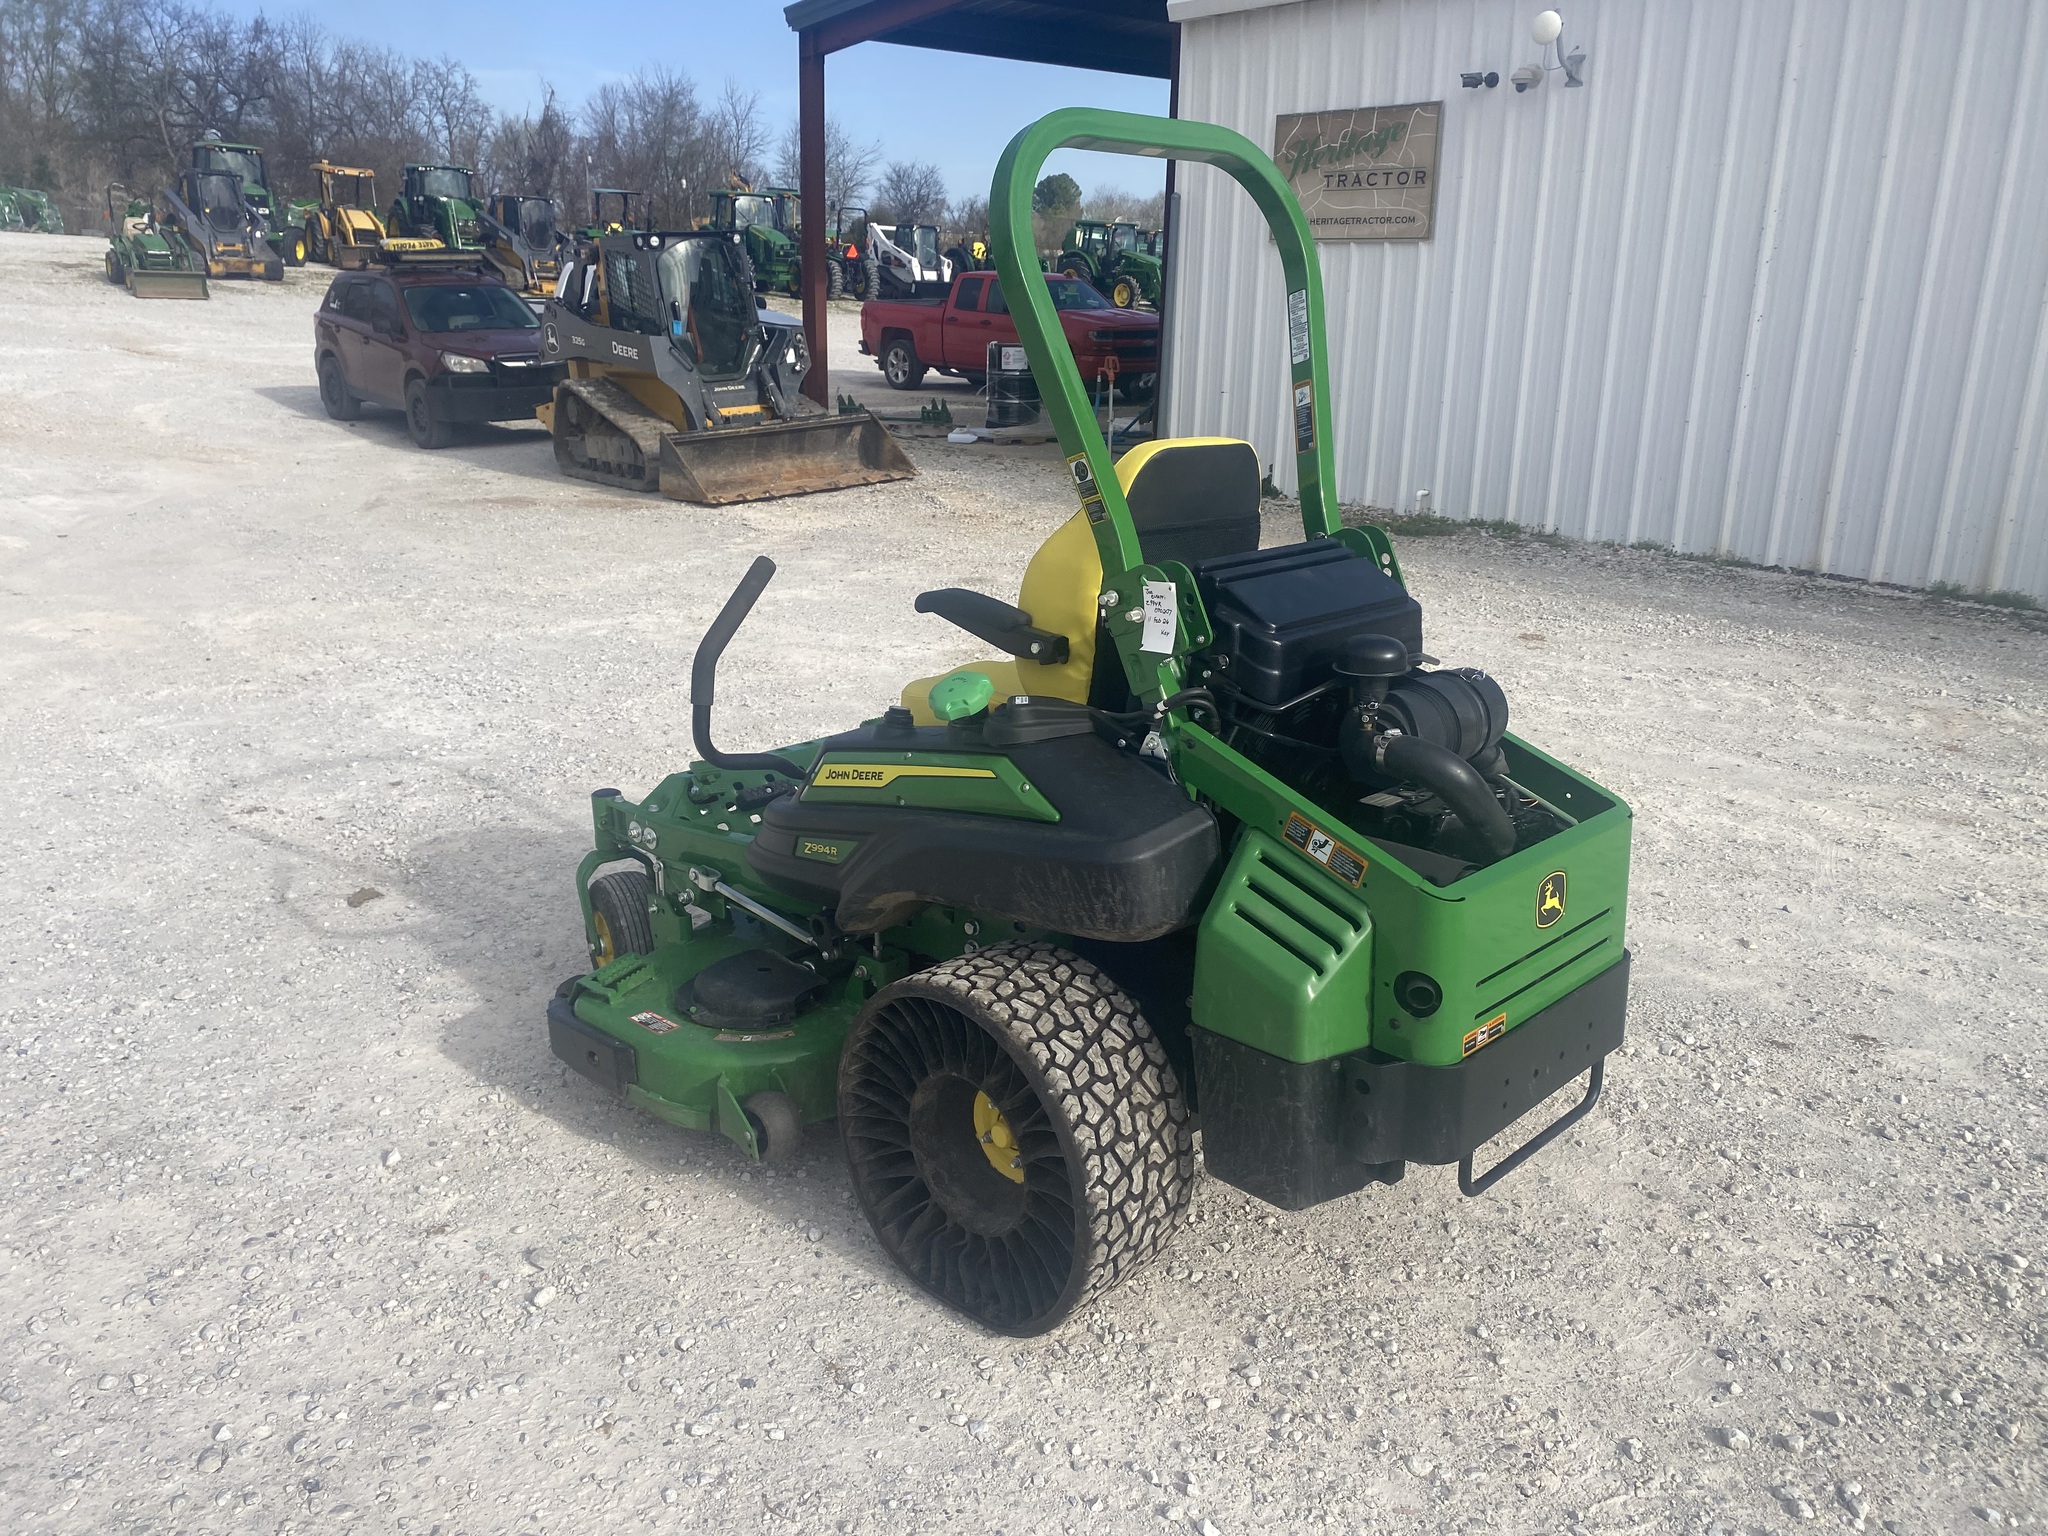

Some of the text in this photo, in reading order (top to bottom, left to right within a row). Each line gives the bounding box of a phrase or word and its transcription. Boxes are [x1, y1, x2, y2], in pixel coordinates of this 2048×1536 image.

[1285, 121, 1407, 183] Heritage
[1324, 170, 1427, 188] TRACTOR
[611, 341, 639, 360] DEERE
[825, 768, 884, 781] JOHN DEERE
[804, 842, 837, 856] Z994R
